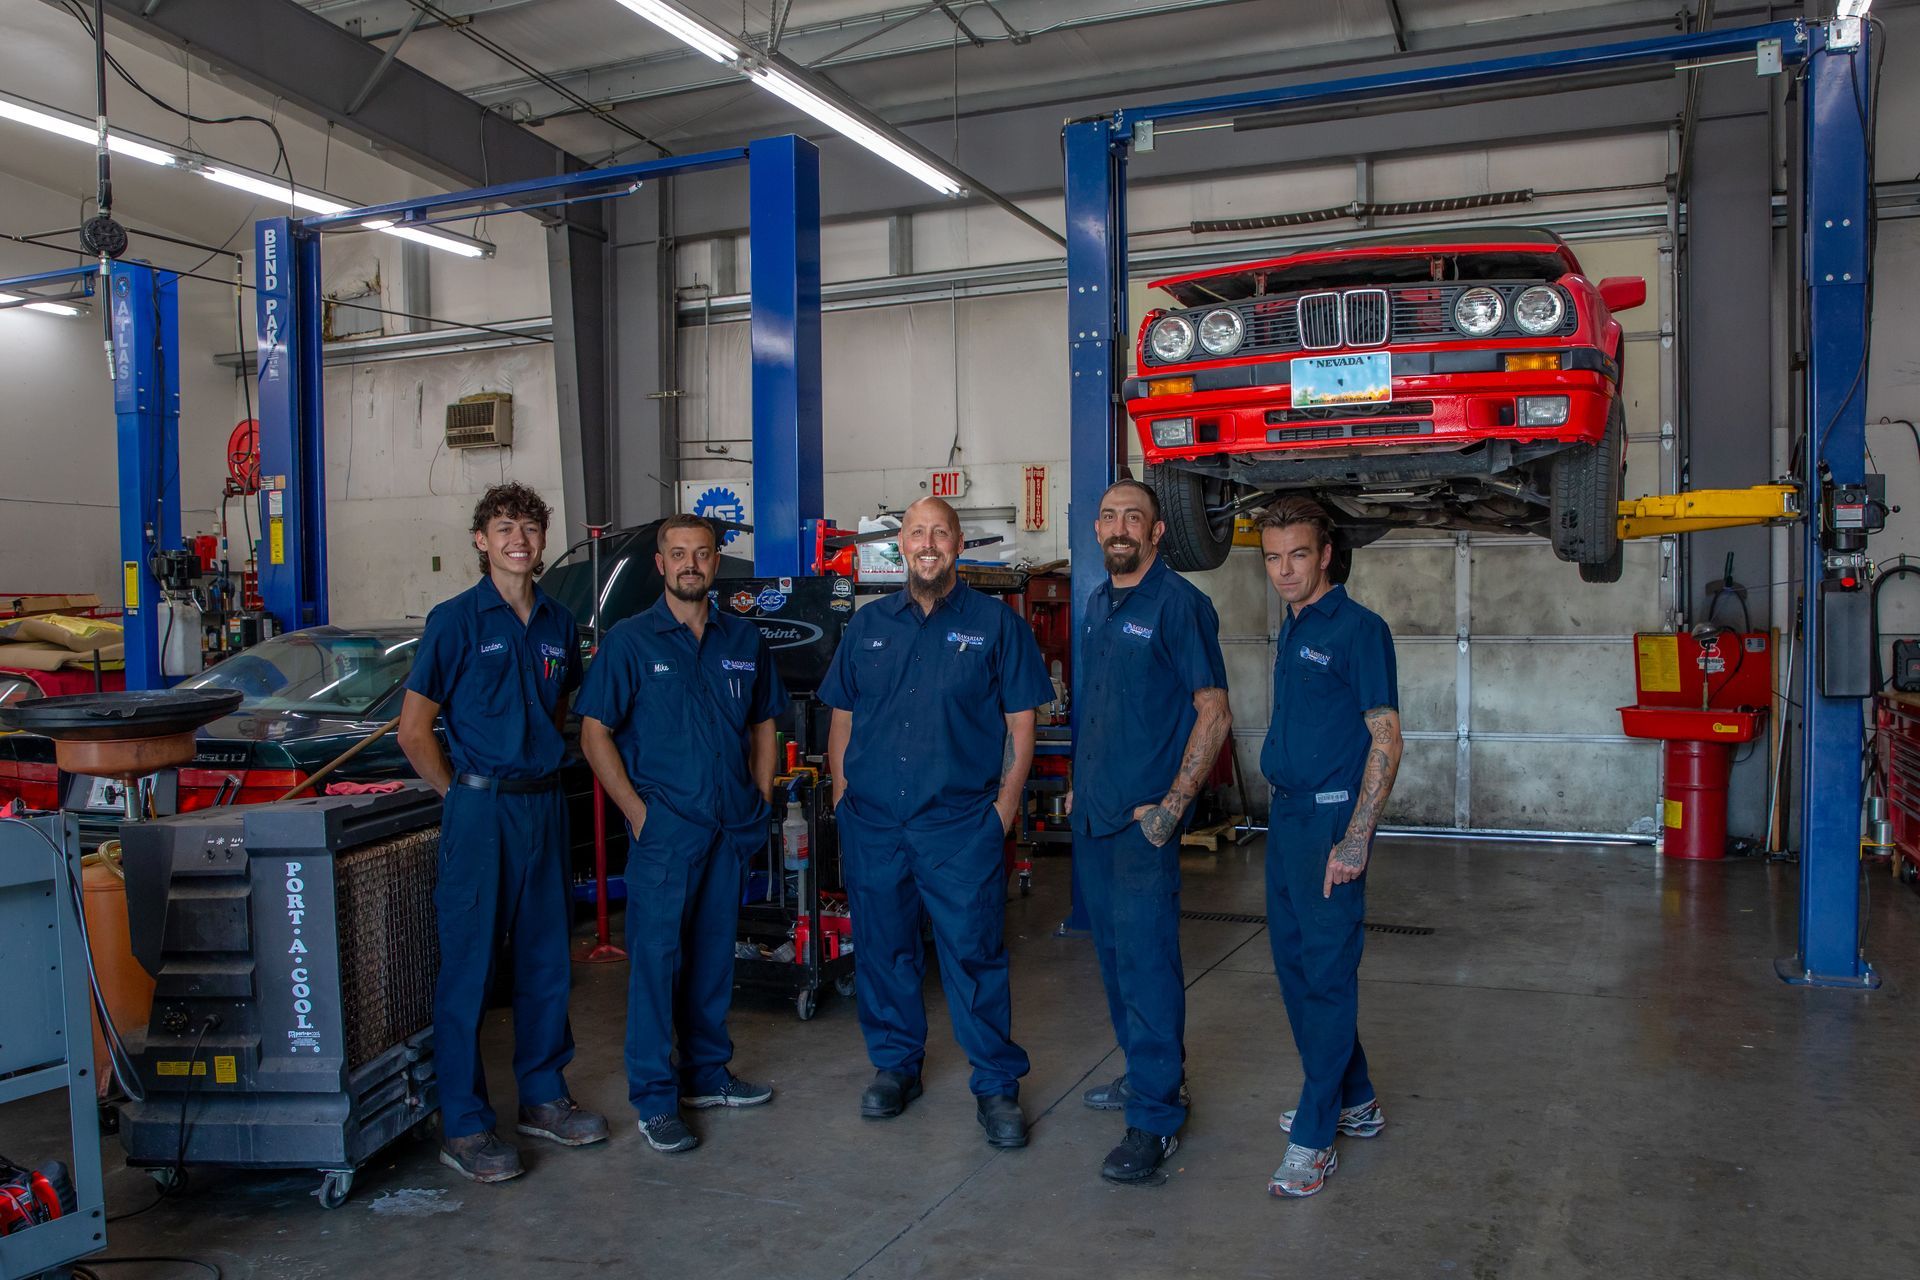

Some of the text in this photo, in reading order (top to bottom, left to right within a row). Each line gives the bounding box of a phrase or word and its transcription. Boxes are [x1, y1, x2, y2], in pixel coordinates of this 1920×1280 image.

[264, 229, 278, 291] BEND
[266, 299, 278, 345] PAK
[115, 300, 131, 380] ATLAS
[1316, 356, 1365, 368] NEVADA
[932, 473, 959, 496] EXIT
[702, 504, 736, 522] ASE
[654, 663, 670, 673] Mike
